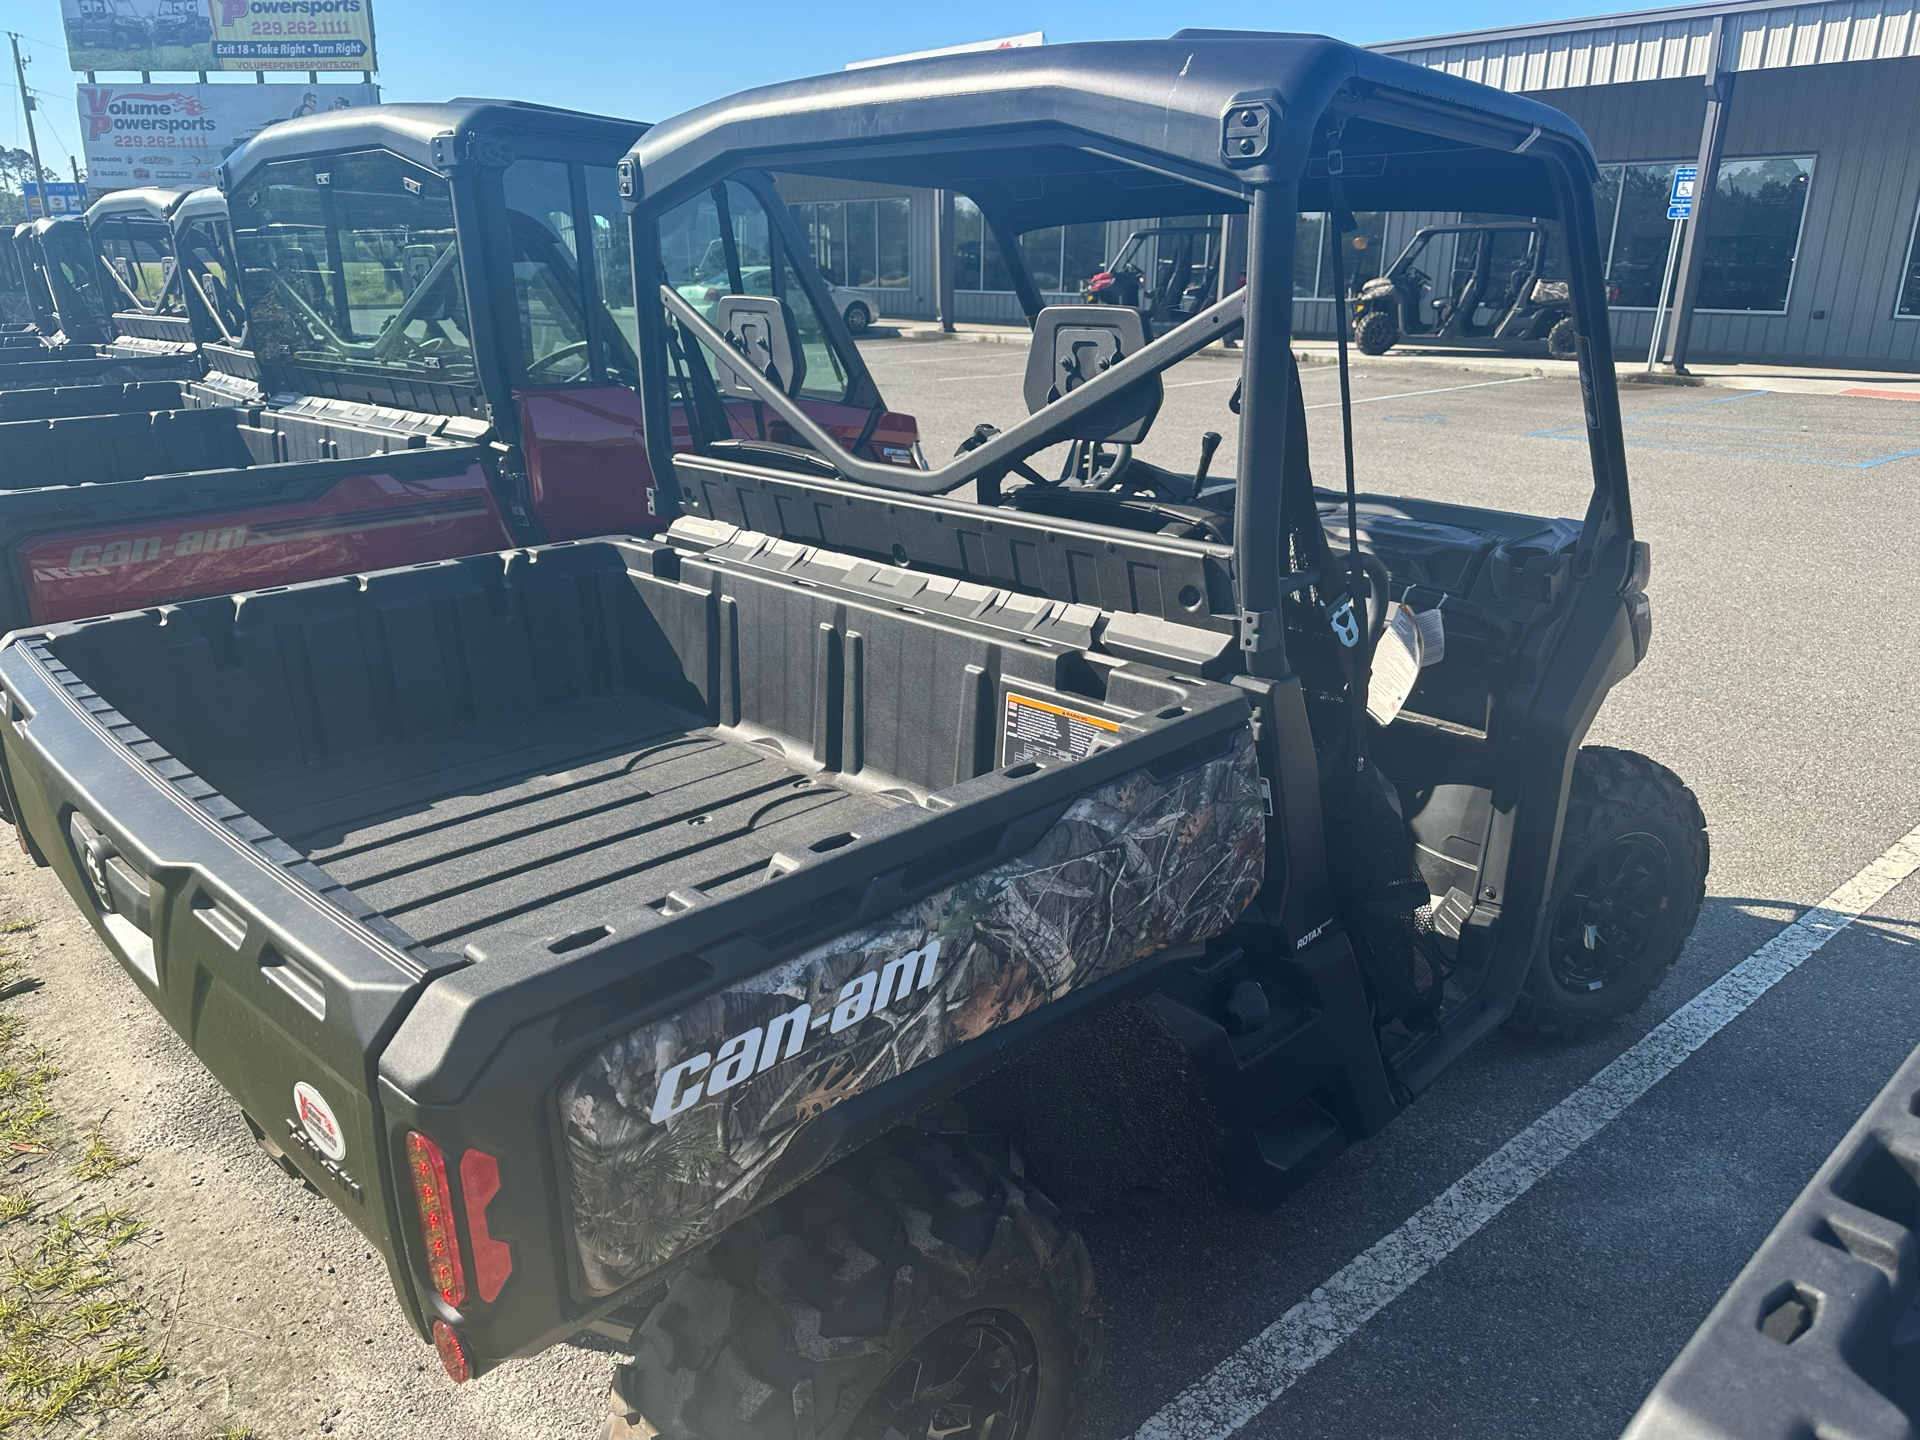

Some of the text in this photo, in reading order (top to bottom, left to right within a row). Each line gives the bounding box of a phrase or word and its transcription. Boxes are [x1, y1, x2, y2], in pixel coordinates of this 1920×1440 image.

[218, 0, 360, 27] Powersports
[252, 21, 350, 35] 229.262.1111
[216, 42, 361, 57] Exit 18 Take Right Turn Right
[236, 61, 360, 70] VOLUMEPOWERSPORTS.COM
[79, 88, 171, 115] Volume
[83, 115, 216, 141] Powersports
[114, 135, 208, 149] 229.262.1111
[68, 524, 248, 572] can-am
[1297, 926, 1322, 950] ROTAX
[651, 940, 941, 1124] can-am
